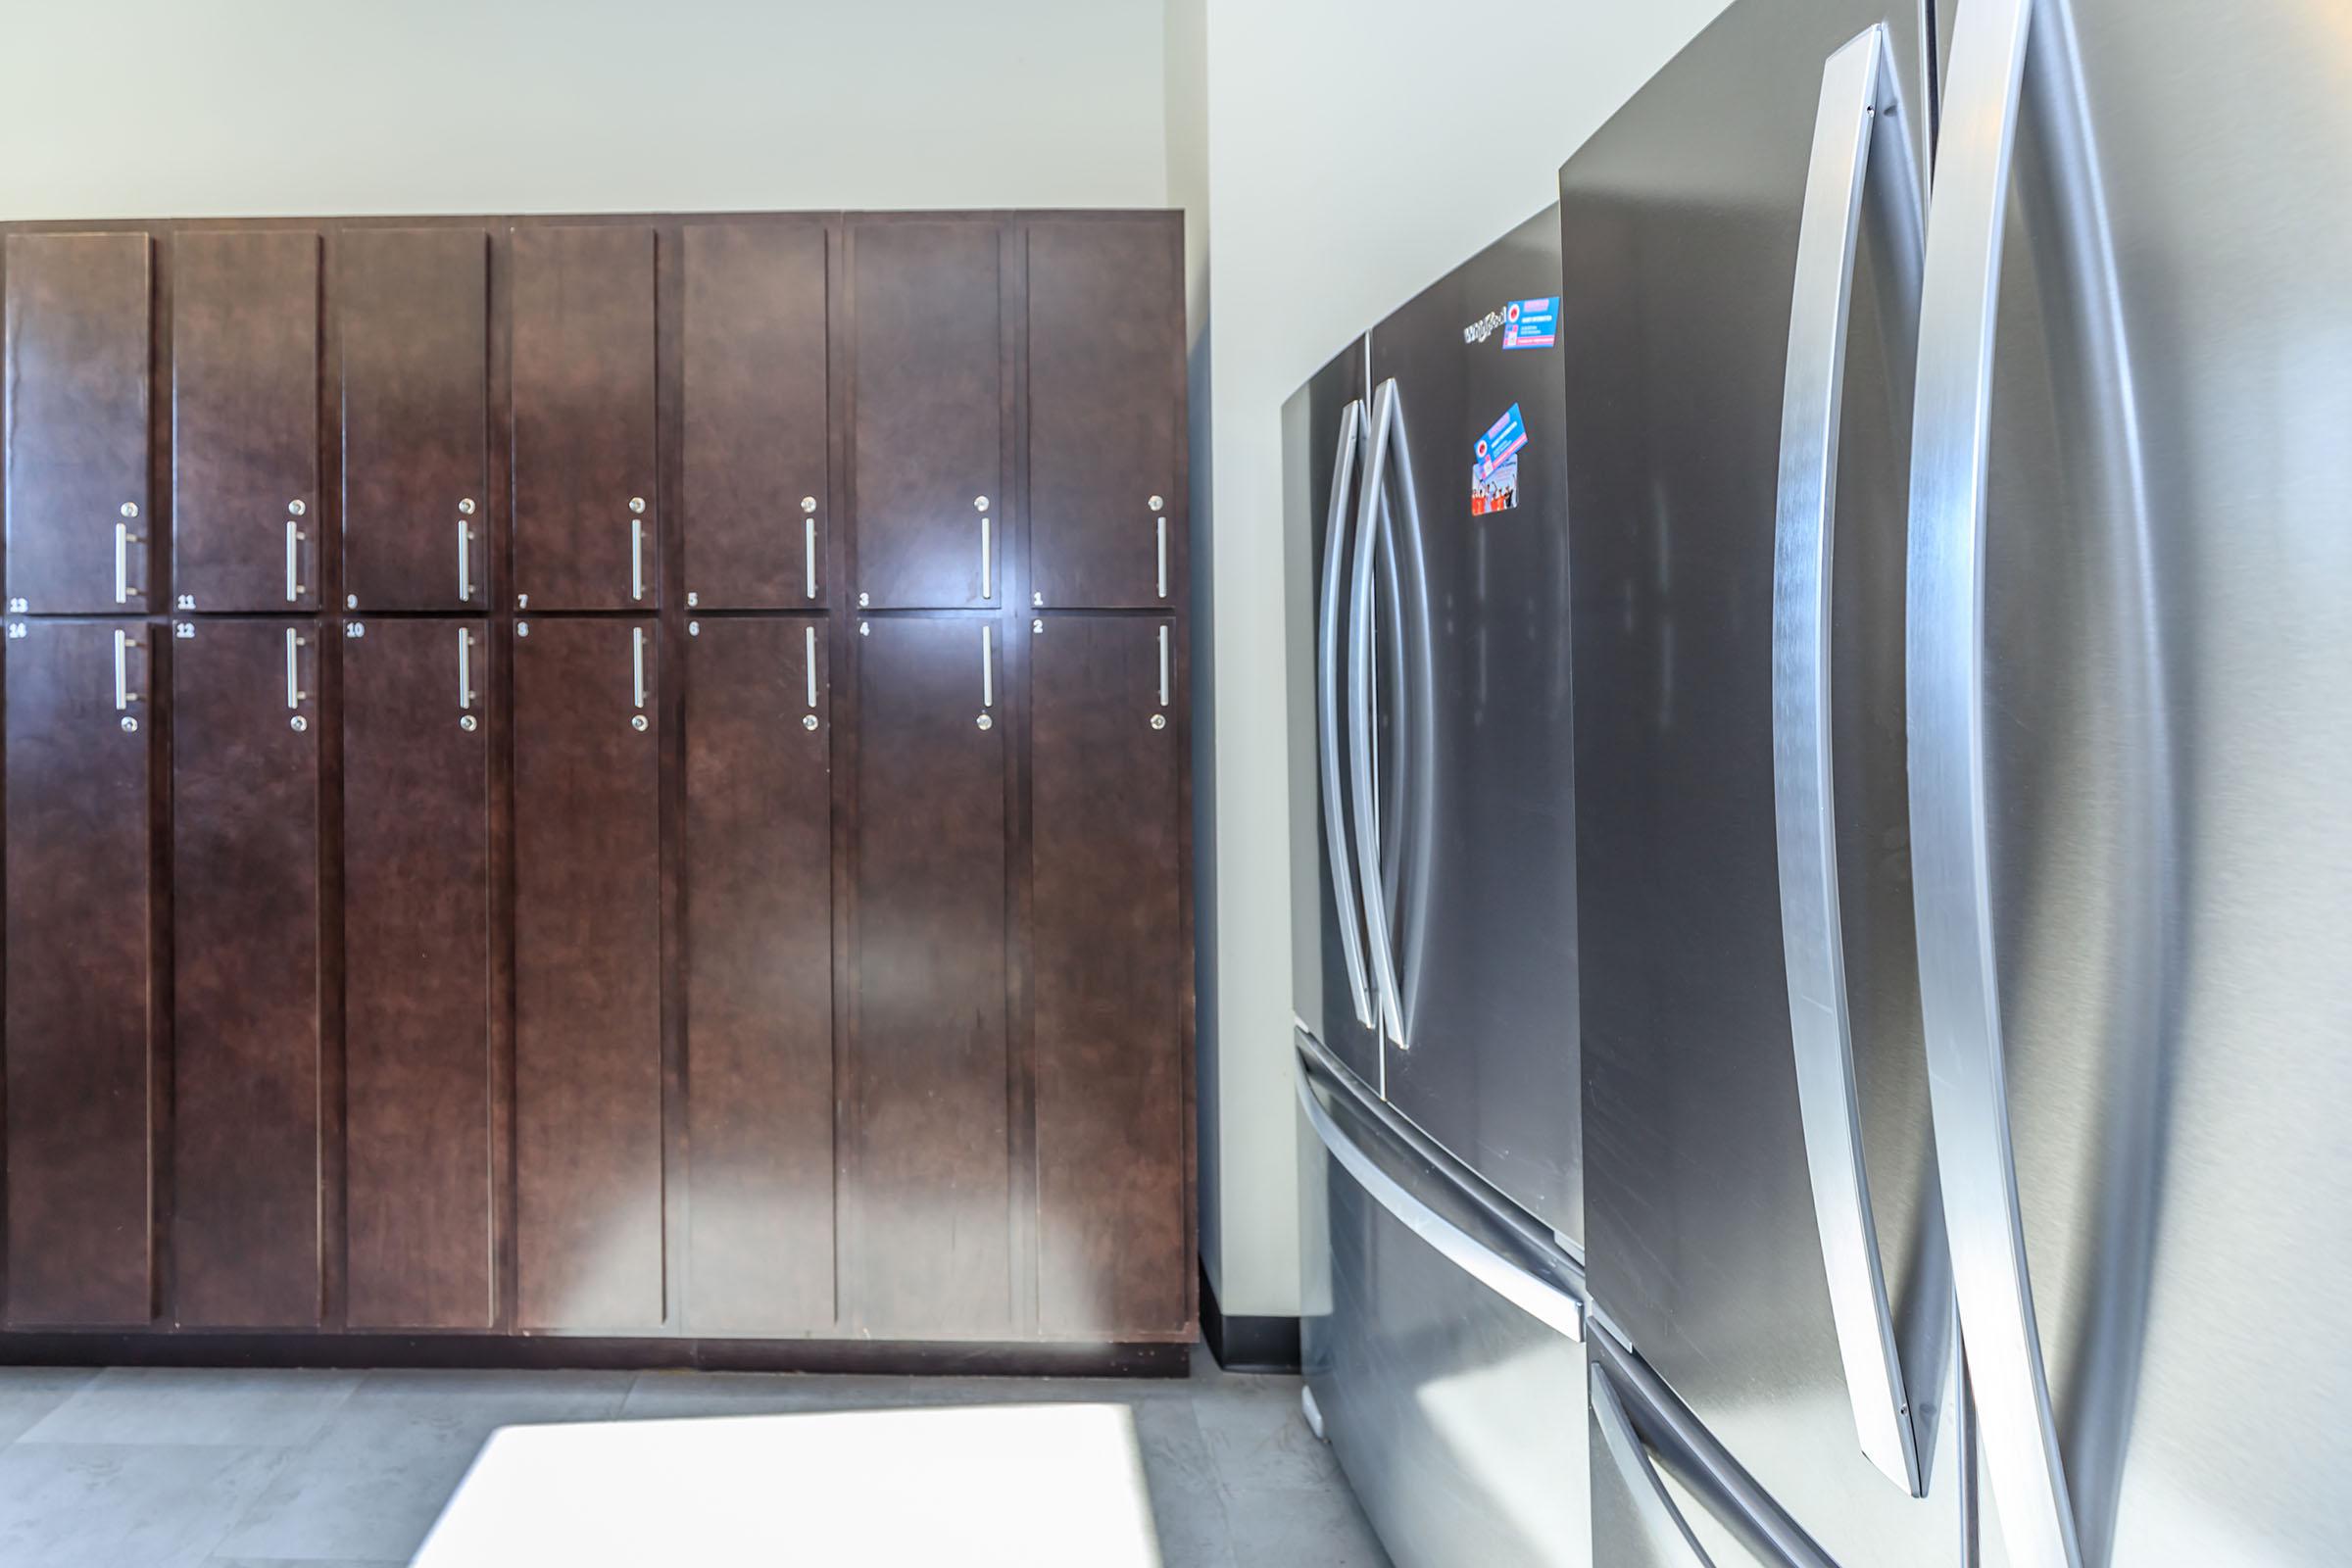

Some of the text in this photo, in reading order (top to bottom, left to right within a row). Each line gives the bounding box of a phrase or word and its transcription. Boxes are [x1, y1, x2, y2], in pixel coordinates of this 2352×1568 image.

[1463, 306, 1507, 343] Whirlpool
[9, 597, 28, 613] 13
[177, 594, 196, 610] 11
[346, 594, 357, 609] 9
[517, 594, 528, 609] 7
[687, 592, 698, 607] 5
[858, 592, 869, 607] 3
[1032, 591, 1043, 607] 1
[9, 622, 27, 638] 14
[176, 622, 195, 638] 12
[346, 622, 365, 637] 10
[516, 622, 529, 637] 8
[859, 621, 871, 636] 4
[1033, 618, 1044, 634] 2
